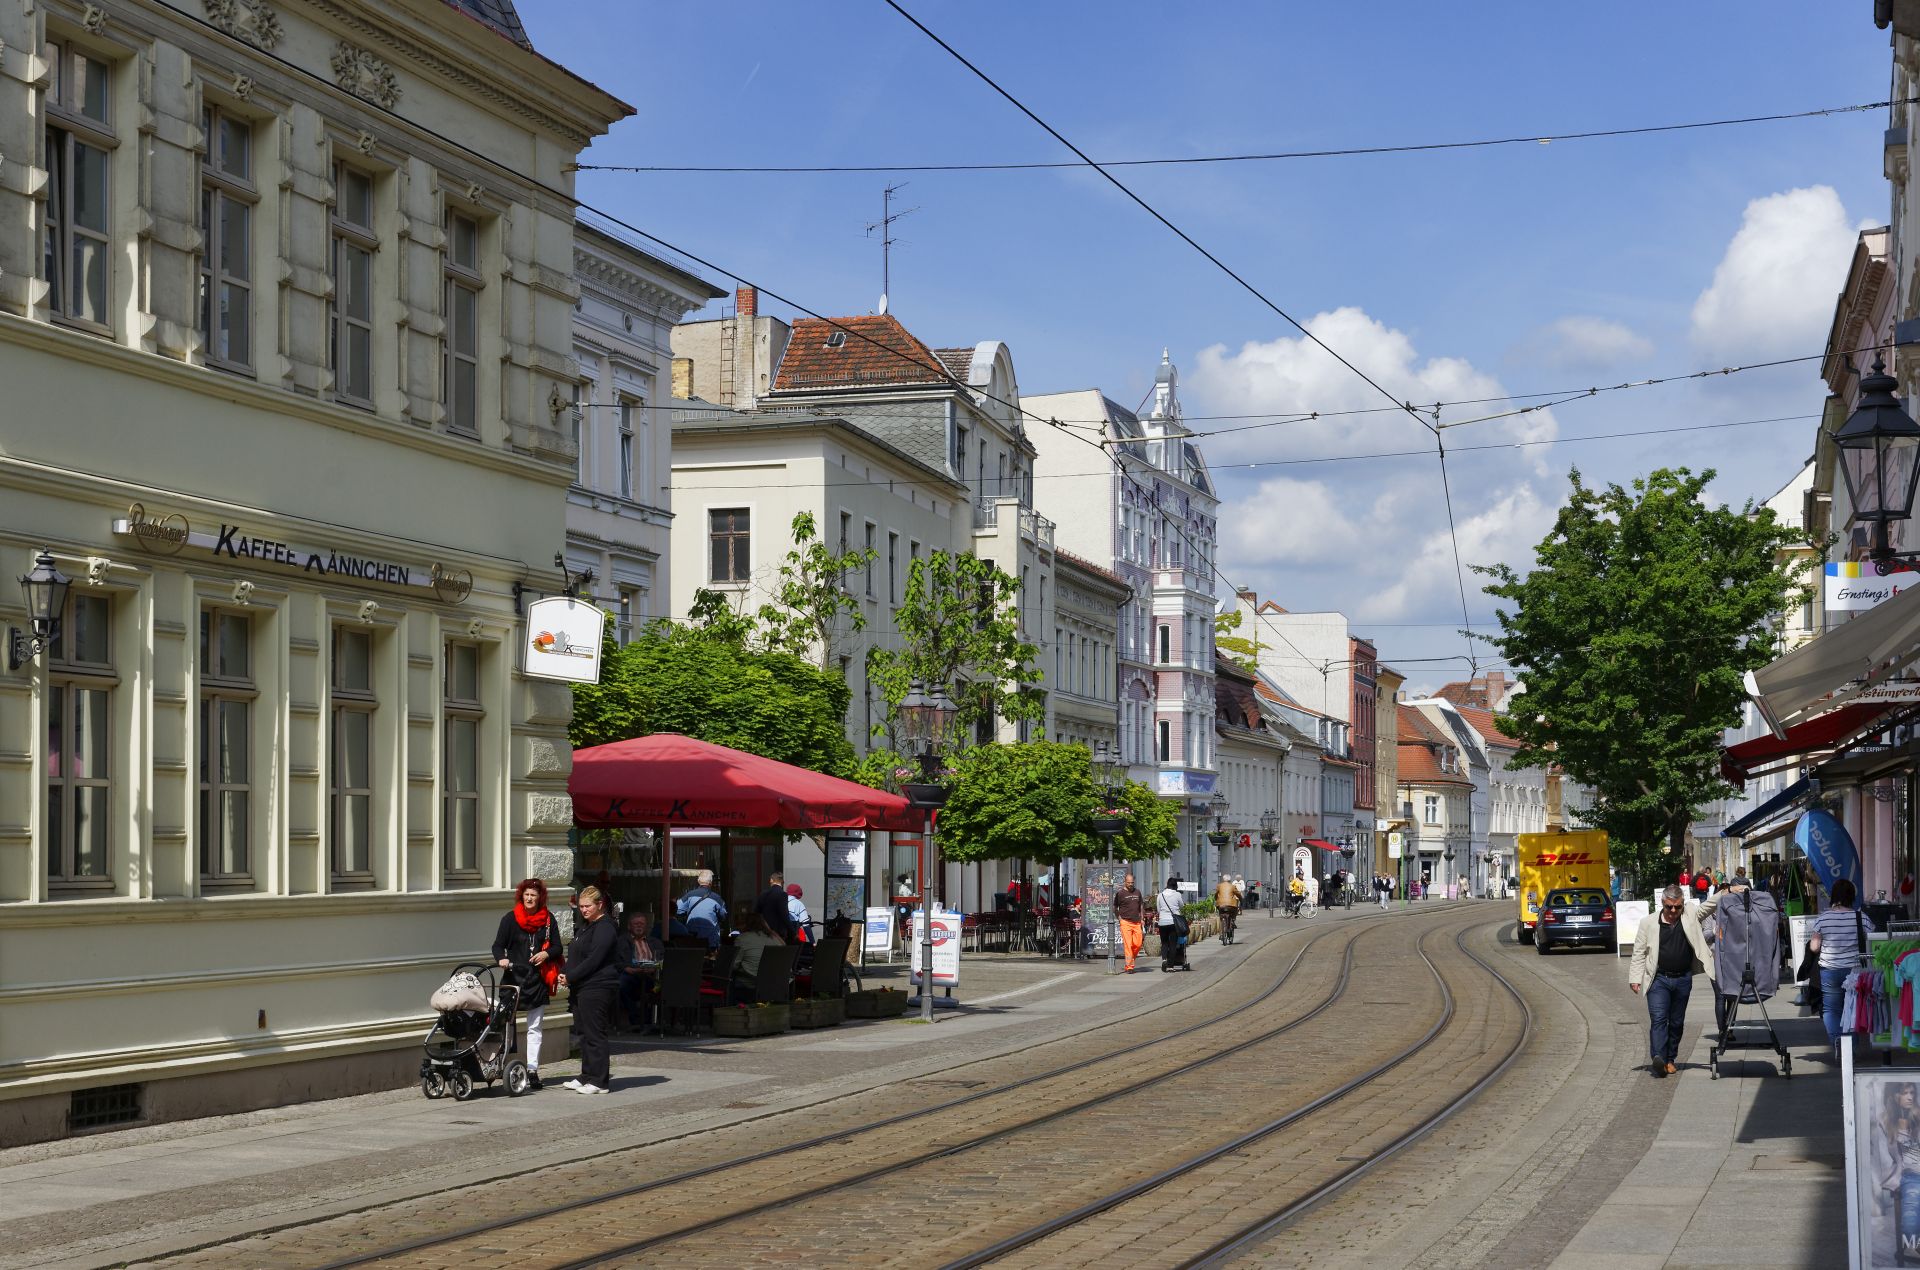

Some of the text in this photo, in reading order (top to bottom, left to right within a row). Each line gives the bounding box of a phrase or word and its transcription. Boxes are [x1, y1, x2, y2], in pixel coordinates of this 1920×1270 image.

[213, 523, 297, 567] KAFFEE
[1838, 587, 1889, 602] Ernsting's
[1535, 852, 1594, 866] DHL
